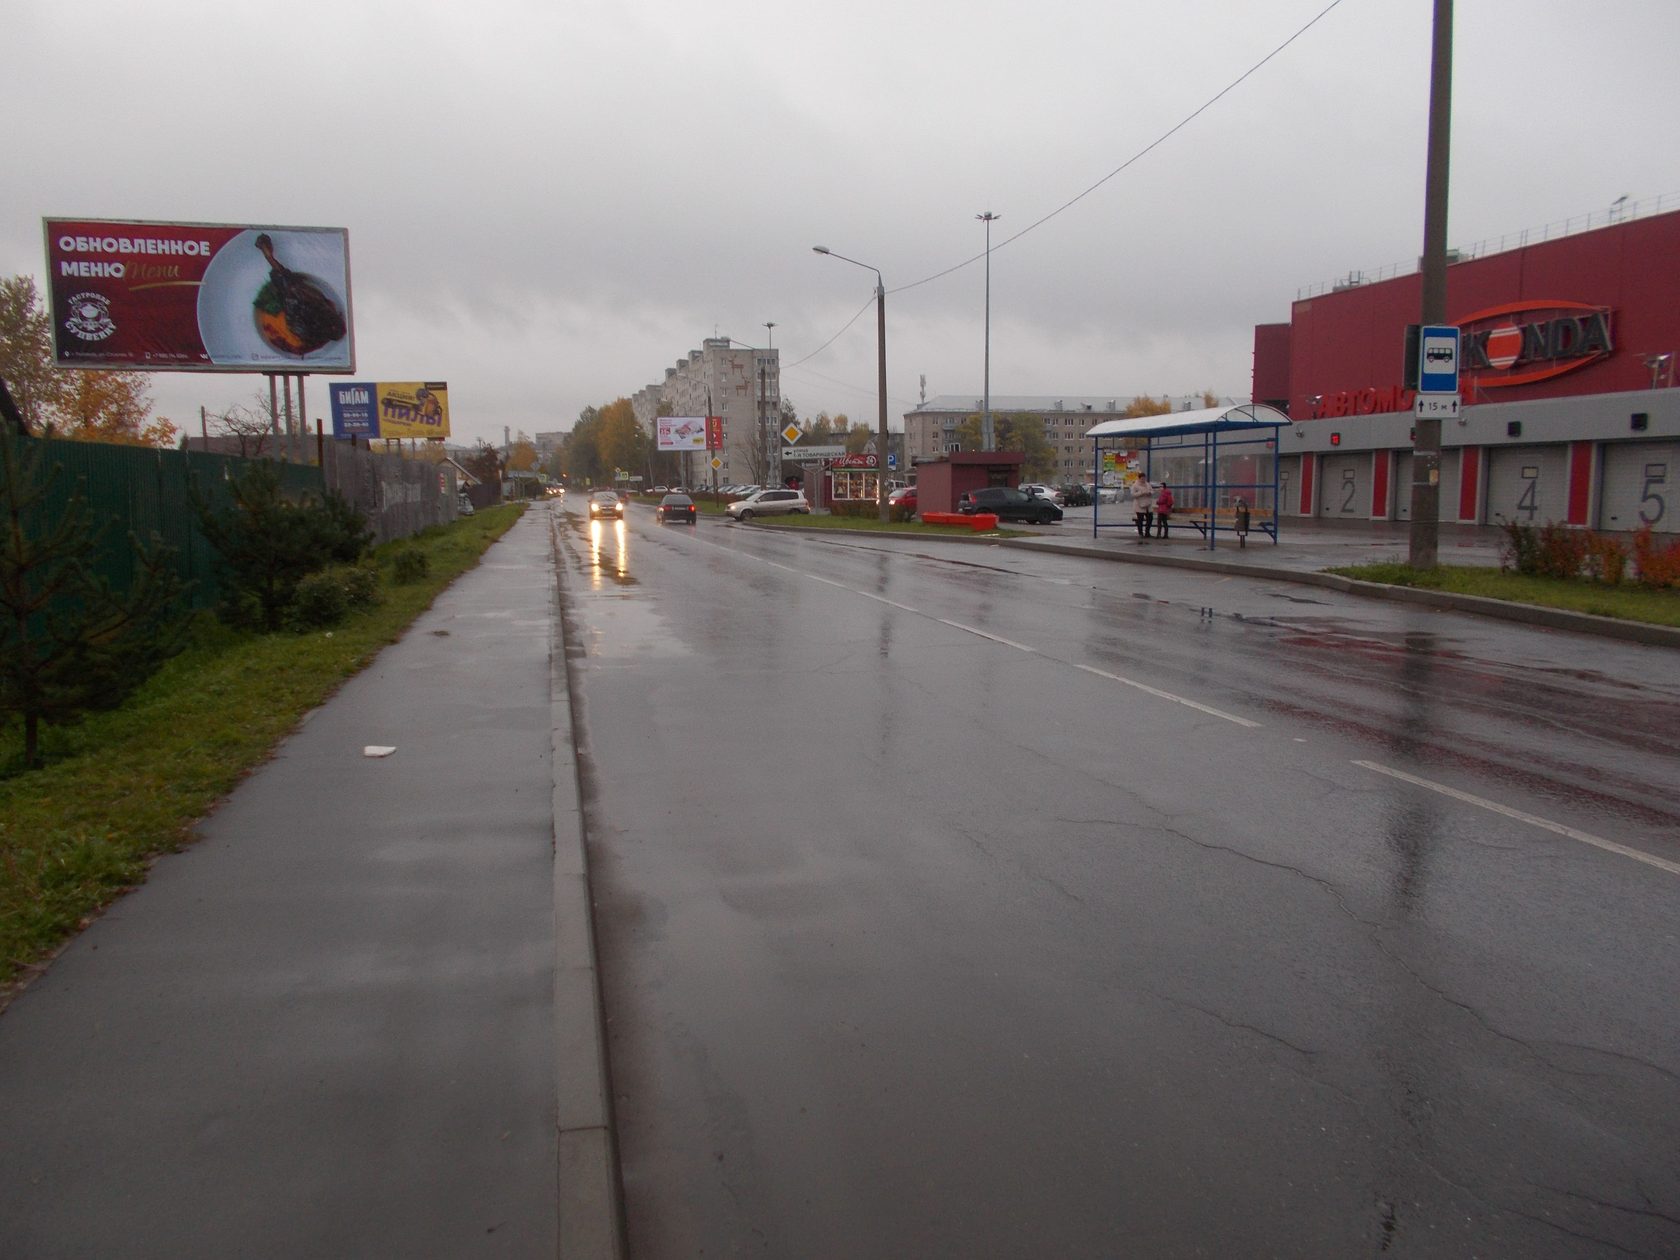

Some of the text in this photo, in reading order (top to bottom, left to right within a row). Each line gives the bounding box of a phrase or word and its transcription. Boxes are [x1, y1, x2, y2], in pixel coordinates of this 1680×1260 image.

[58, 235, 211, 257] ОБНОВЛЕННОЕ
[60, 260, 126, 279] МЕНЮ
[1464, 312, 1613, 369] KONDA
[338, 387, 369, 405] БИГАМ
[1428, 402, 1438, 410] 15
[1340, 479, 1355, 513] 2
[1517, 479, 1538, 520] 4
[1639, 478, 1666, 525] 5
